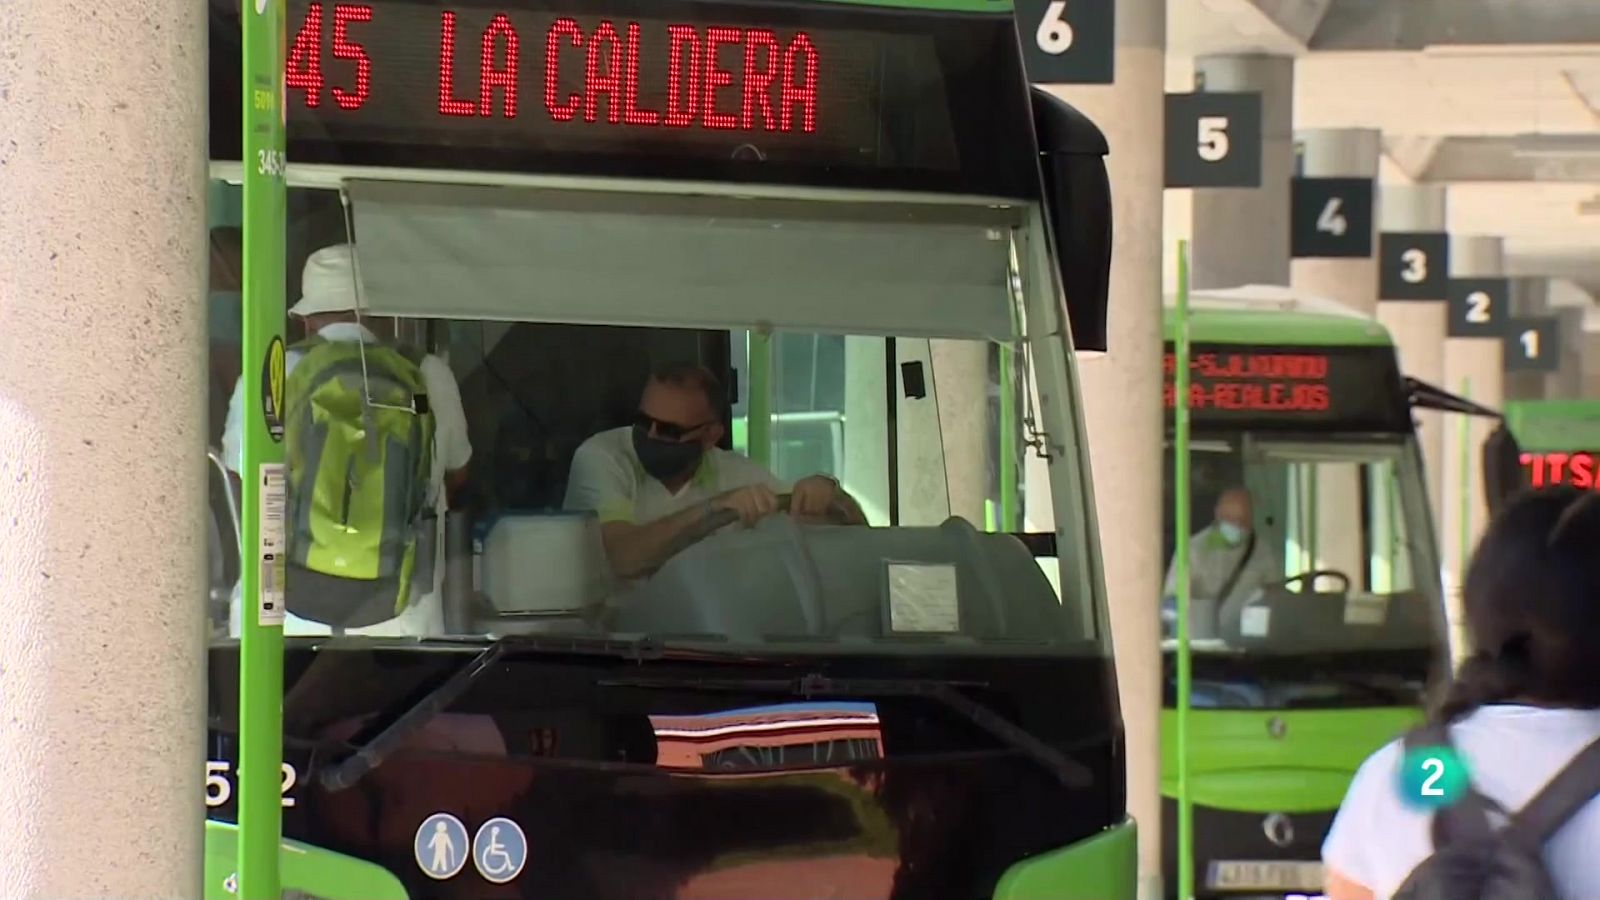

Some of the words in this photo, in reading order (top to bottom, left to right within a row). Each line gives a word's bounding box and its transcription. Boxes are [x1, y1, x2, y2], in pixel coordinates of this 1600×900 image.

[1036, 1, 1073, 54] 6
[438, 10, 518, 118] LA
[544, 17, 819, 132] CALDERA
[1197, 117, 1229, 161] 5
[1316, 198, 1347, 236] 4
[1401, 249, 1426, 282] 3
[1466, 292, 1490, 323] 2
[1521, 330, 1538, 358] 1
[1519, 452, 1600, 488] ITS
[205, 761, 297, 807] 52
